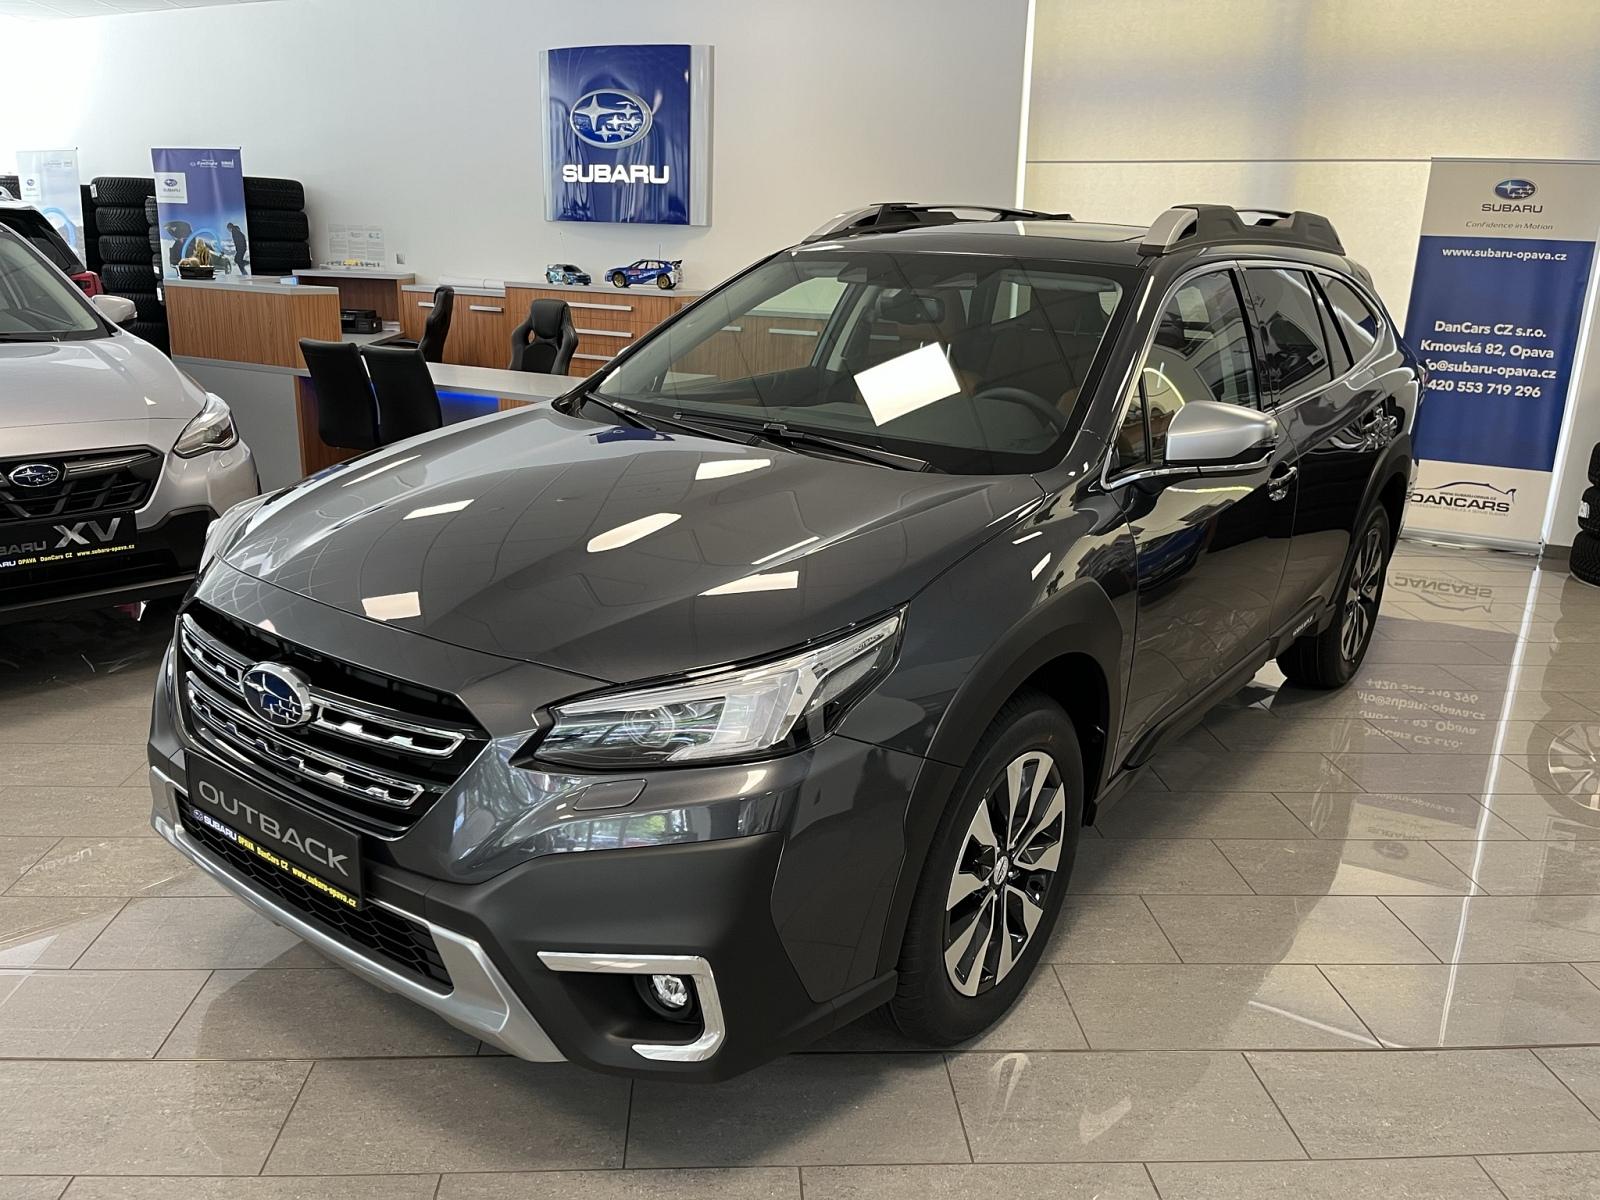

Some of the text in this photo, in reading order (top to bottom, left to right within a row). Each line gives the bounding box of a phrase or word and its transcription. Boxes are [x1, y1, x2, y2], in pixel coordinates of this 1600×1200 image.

[562, 164, 670, 184] SUBARU
[1481, 203, 1543, 213] SUBARU
[1465, 221, 1514, 229] Confidence
[1442, 247, 1567, 261] www.subaru-opava.cz
[1434, 320, 1547, 338] DanCars CZ s.r.o.
[1420, 339, 1555, 359] Krnovská 82, Opava
[1456, 381, 1483, 393] 553
[1486, 383, 1512, 396] 719
[1514, 385, 1541, 398] 296
[52, 517, 121, 549] XV
[40, 554, 64, 562] DanCars
[199, 780, 349, 877] OUTBACK
[203, 815, 237, 841] SUBARU
[280, 859, 289, 871] CZ
